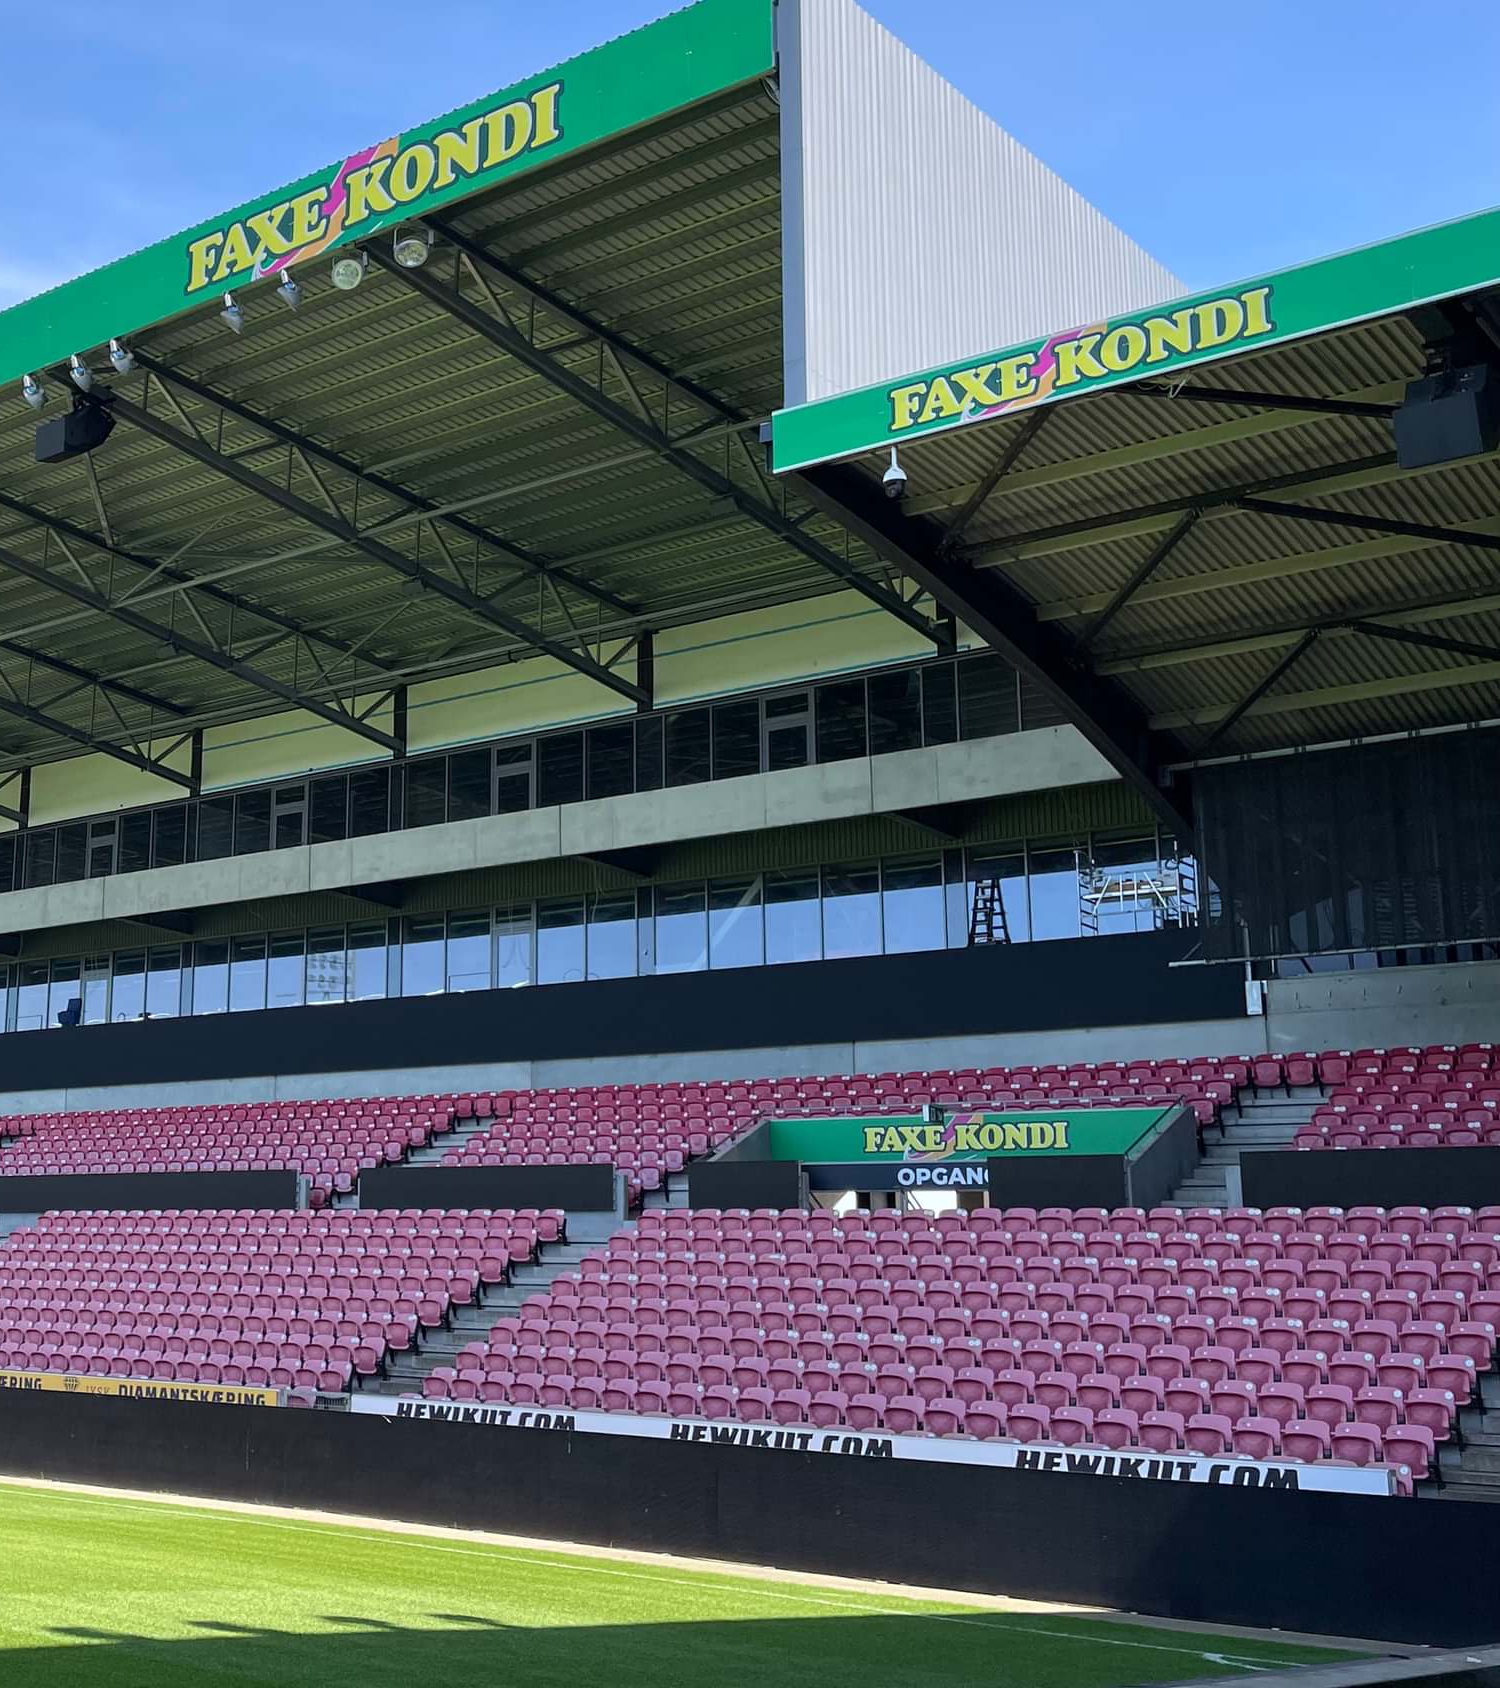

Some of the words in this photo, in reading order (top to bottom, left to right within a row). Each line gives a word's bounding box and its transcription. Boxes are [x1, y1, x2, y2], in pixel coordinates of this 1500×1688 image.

[186, 186, 330, 292] FAXE
[343, 83, 561, 226] KONDI
[890, 352, 1039, 430] FAXE
[1054, 287, 1272, 387] KONDI
[864, 1125, 946, 1152] FAXE
[954, 1121, 1069, 1150] KONDI
[897, 1167, 989, 1186] OPGAN
